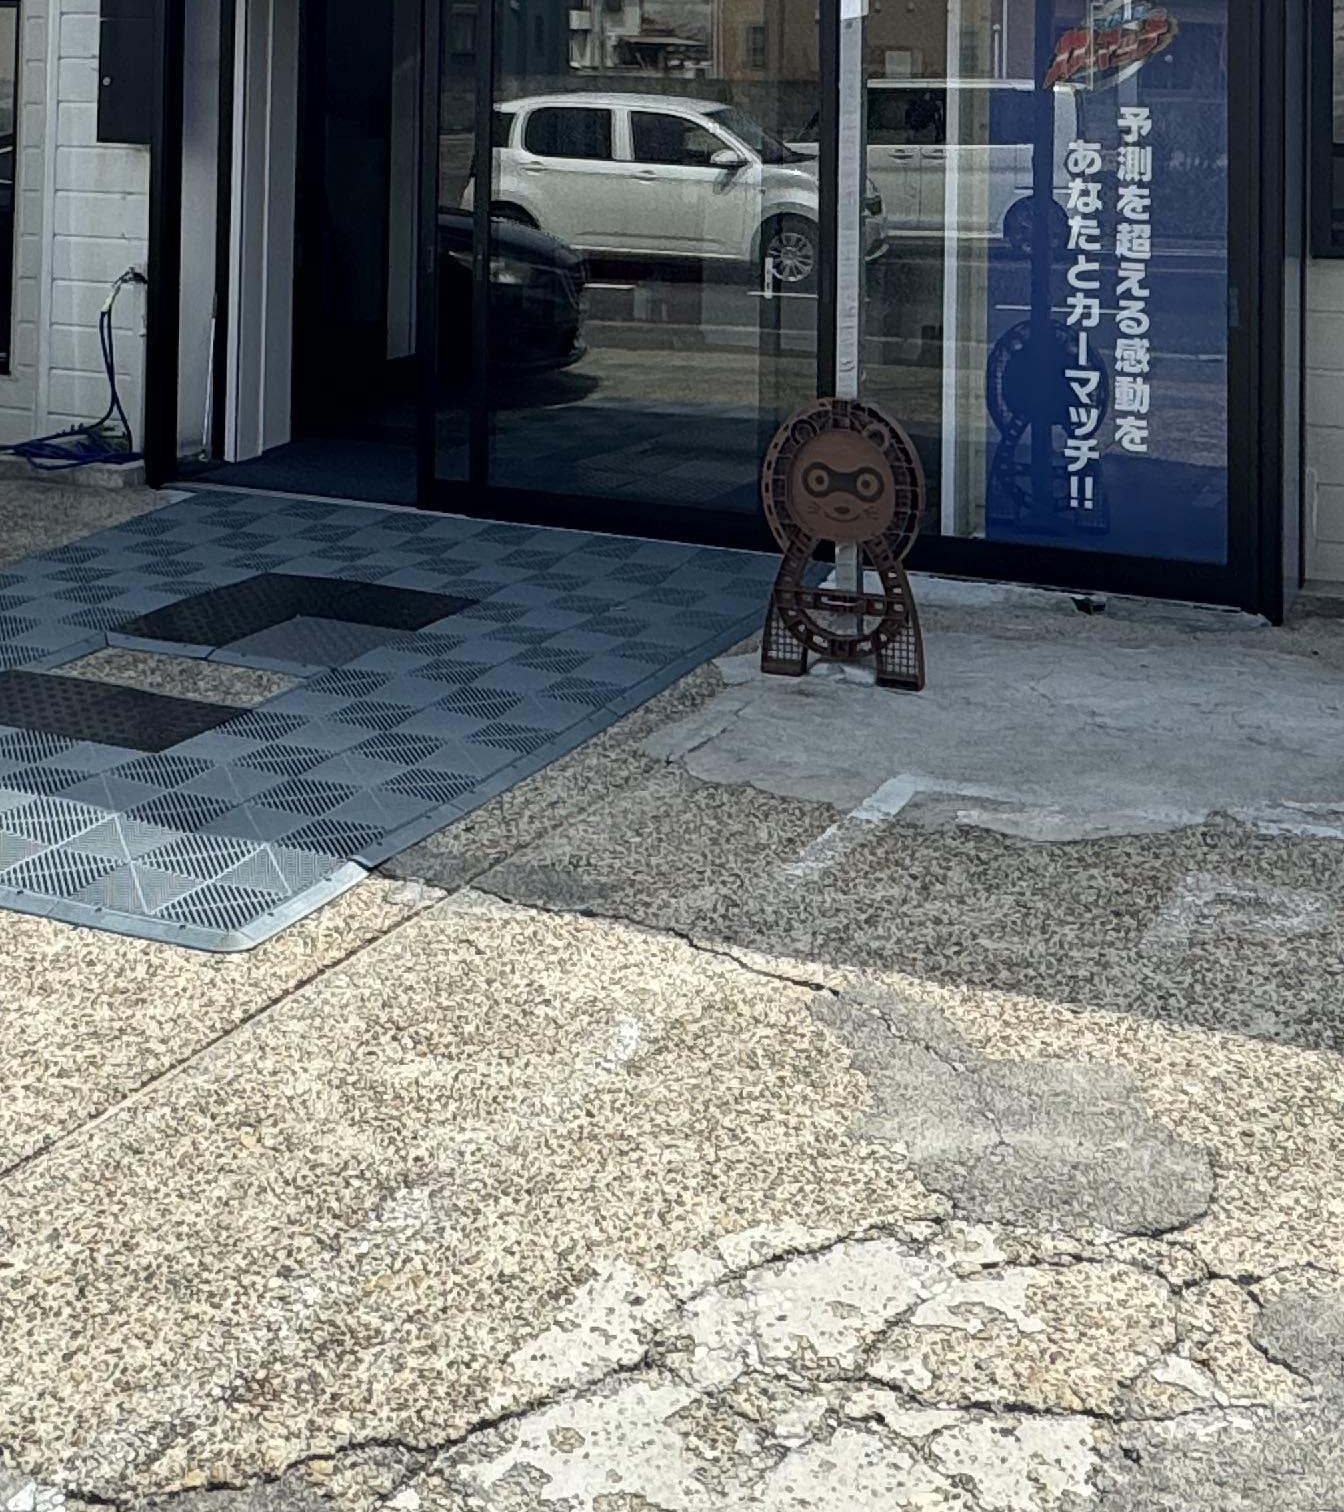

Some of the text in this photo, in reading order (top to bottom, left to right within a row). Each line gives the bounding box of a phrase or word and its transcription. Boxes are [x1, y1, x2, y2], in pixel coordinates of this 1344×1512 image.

[1114, 106, 1153, 453] 予測を超える感動を
